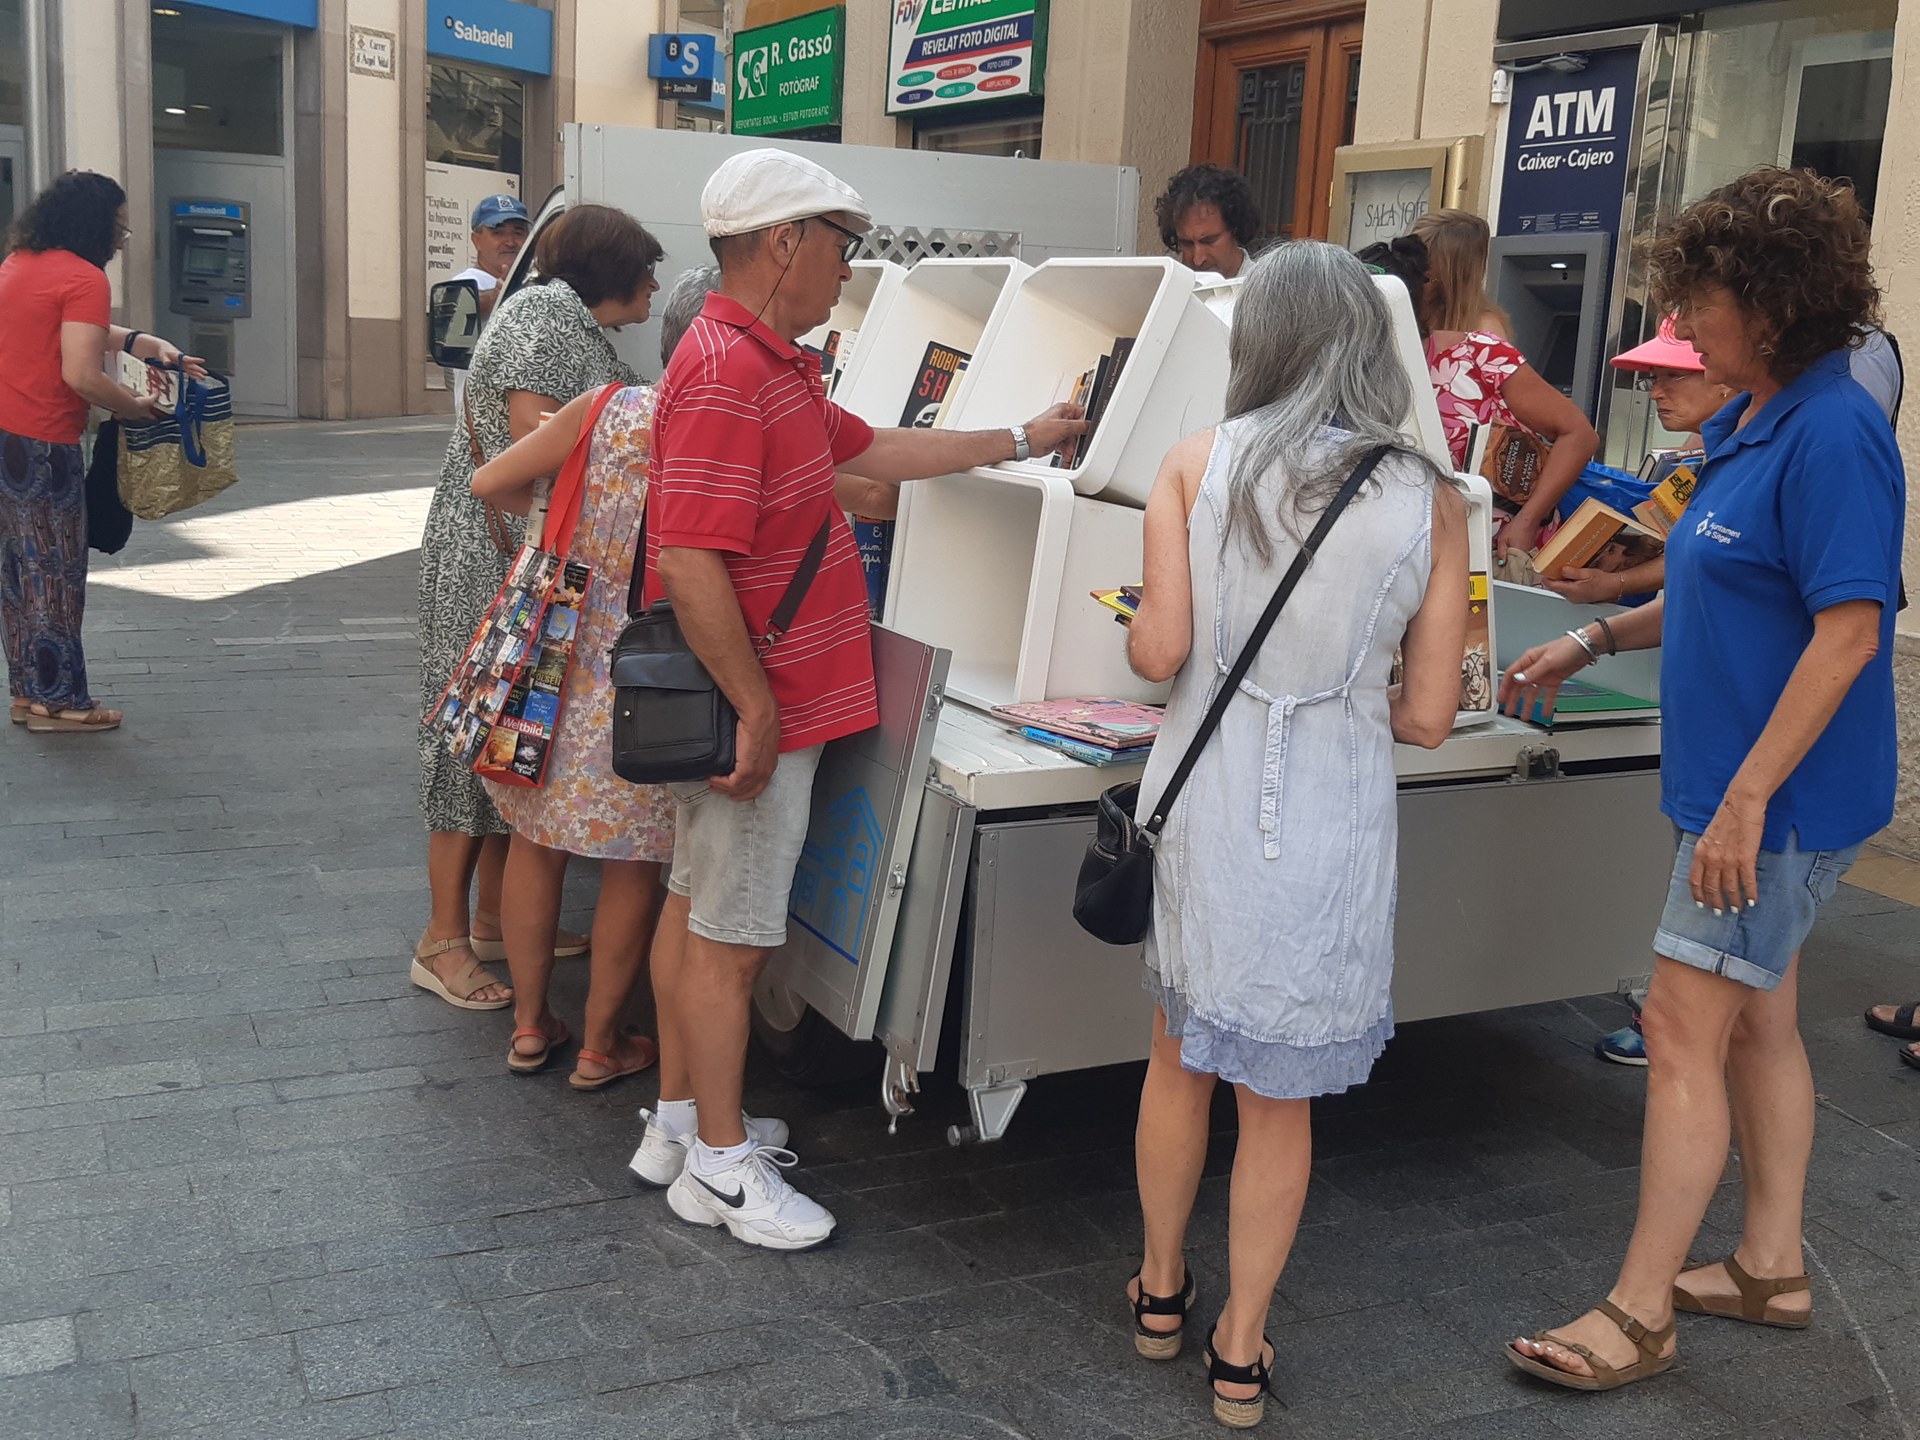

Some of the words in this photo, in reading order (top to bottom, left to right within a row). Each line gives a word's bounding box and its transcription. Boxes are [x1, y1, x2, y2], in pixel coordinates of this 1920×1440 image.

[454, 20, 514, 49] Sabadell
[771, 42, 783, 66] R.
[788, 24, 832, 62] Gassó
[921, 36, 957, 56] REVELAT
[958, 30, 982, 49] FOTO
[983, 22, 1020, 45] DIGITAL
[669, 42, 678, 56] B
[681, 41, 699, 75] S
[779, 75, 820, 97] FOTÒGRAF
[1525, 87, 1616, 140] ATM
[189, 204, 227, 215] Sabadell
[435, 212, 462, 226] hipoteca
[1365, 203, 1396, 228] SALA
[1505, 439, 1520, 485] FALCONES
[1523, 452, 1531, 475] MANO
[1708, 522, 1741, 538] Ajuntament
[1712, 531, 1731, 544] Sitges
[503, 717, 543, 736] Weltbild
